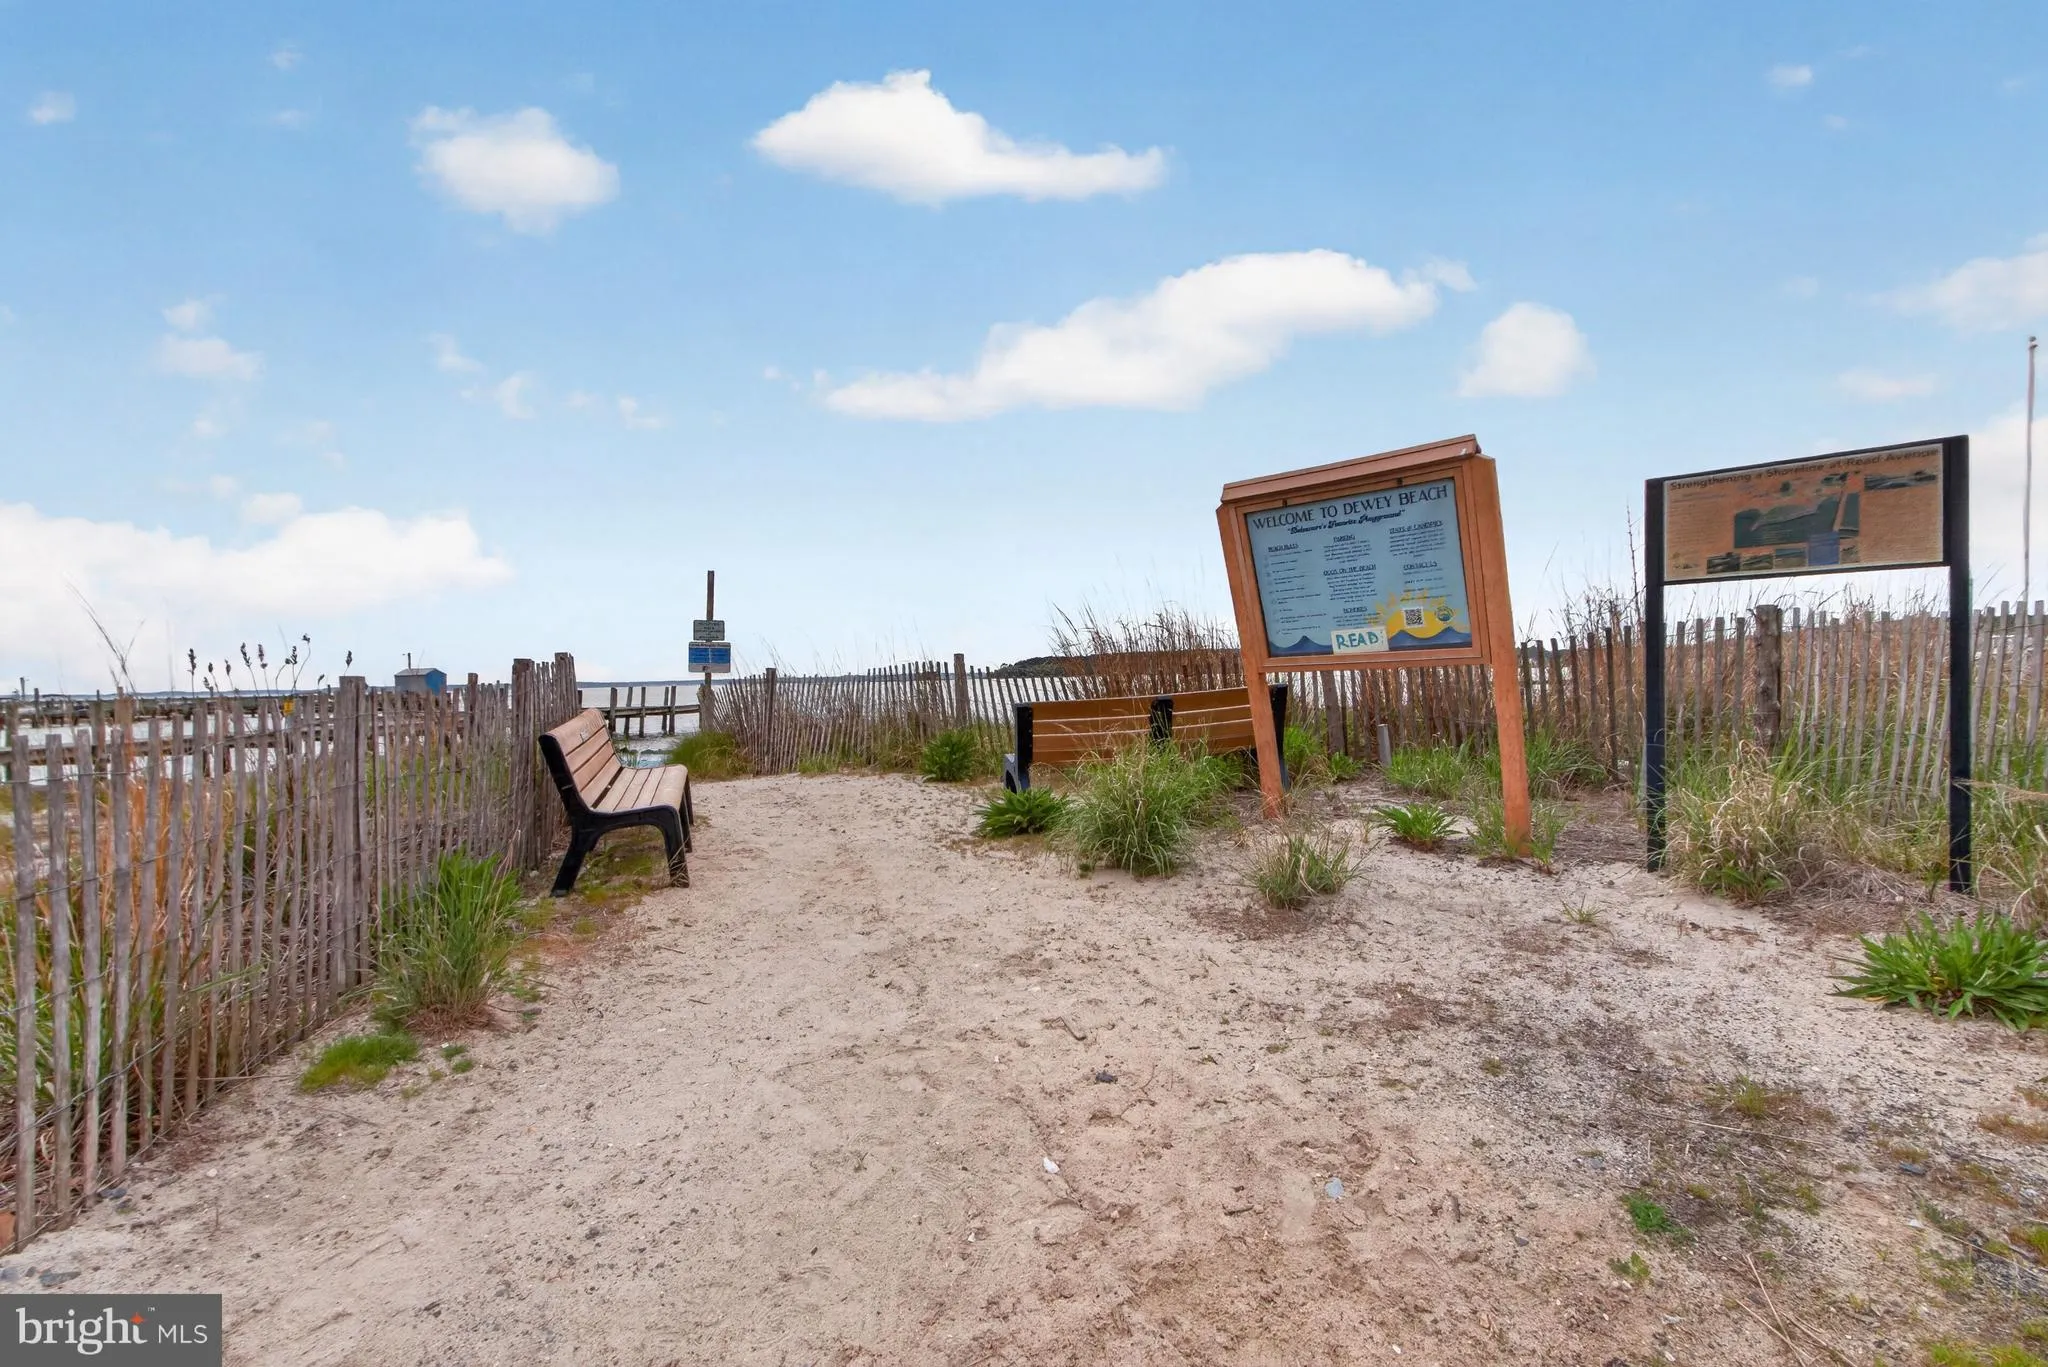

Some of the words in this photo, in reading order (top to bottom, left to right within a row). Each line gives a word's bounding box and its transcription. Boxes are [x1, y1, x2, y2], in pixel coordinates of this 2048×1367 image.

[1670, 474, 1751, 490] Strengthening
[1253, 509, 1314, 530] WELCOME
[1320, 505, 1338, 518] TO
[1343, 495, 1392, 515] DEWEY
[1399, 485, 1448, 505] BEACH
[1335, 631, 1379, 650] READ
